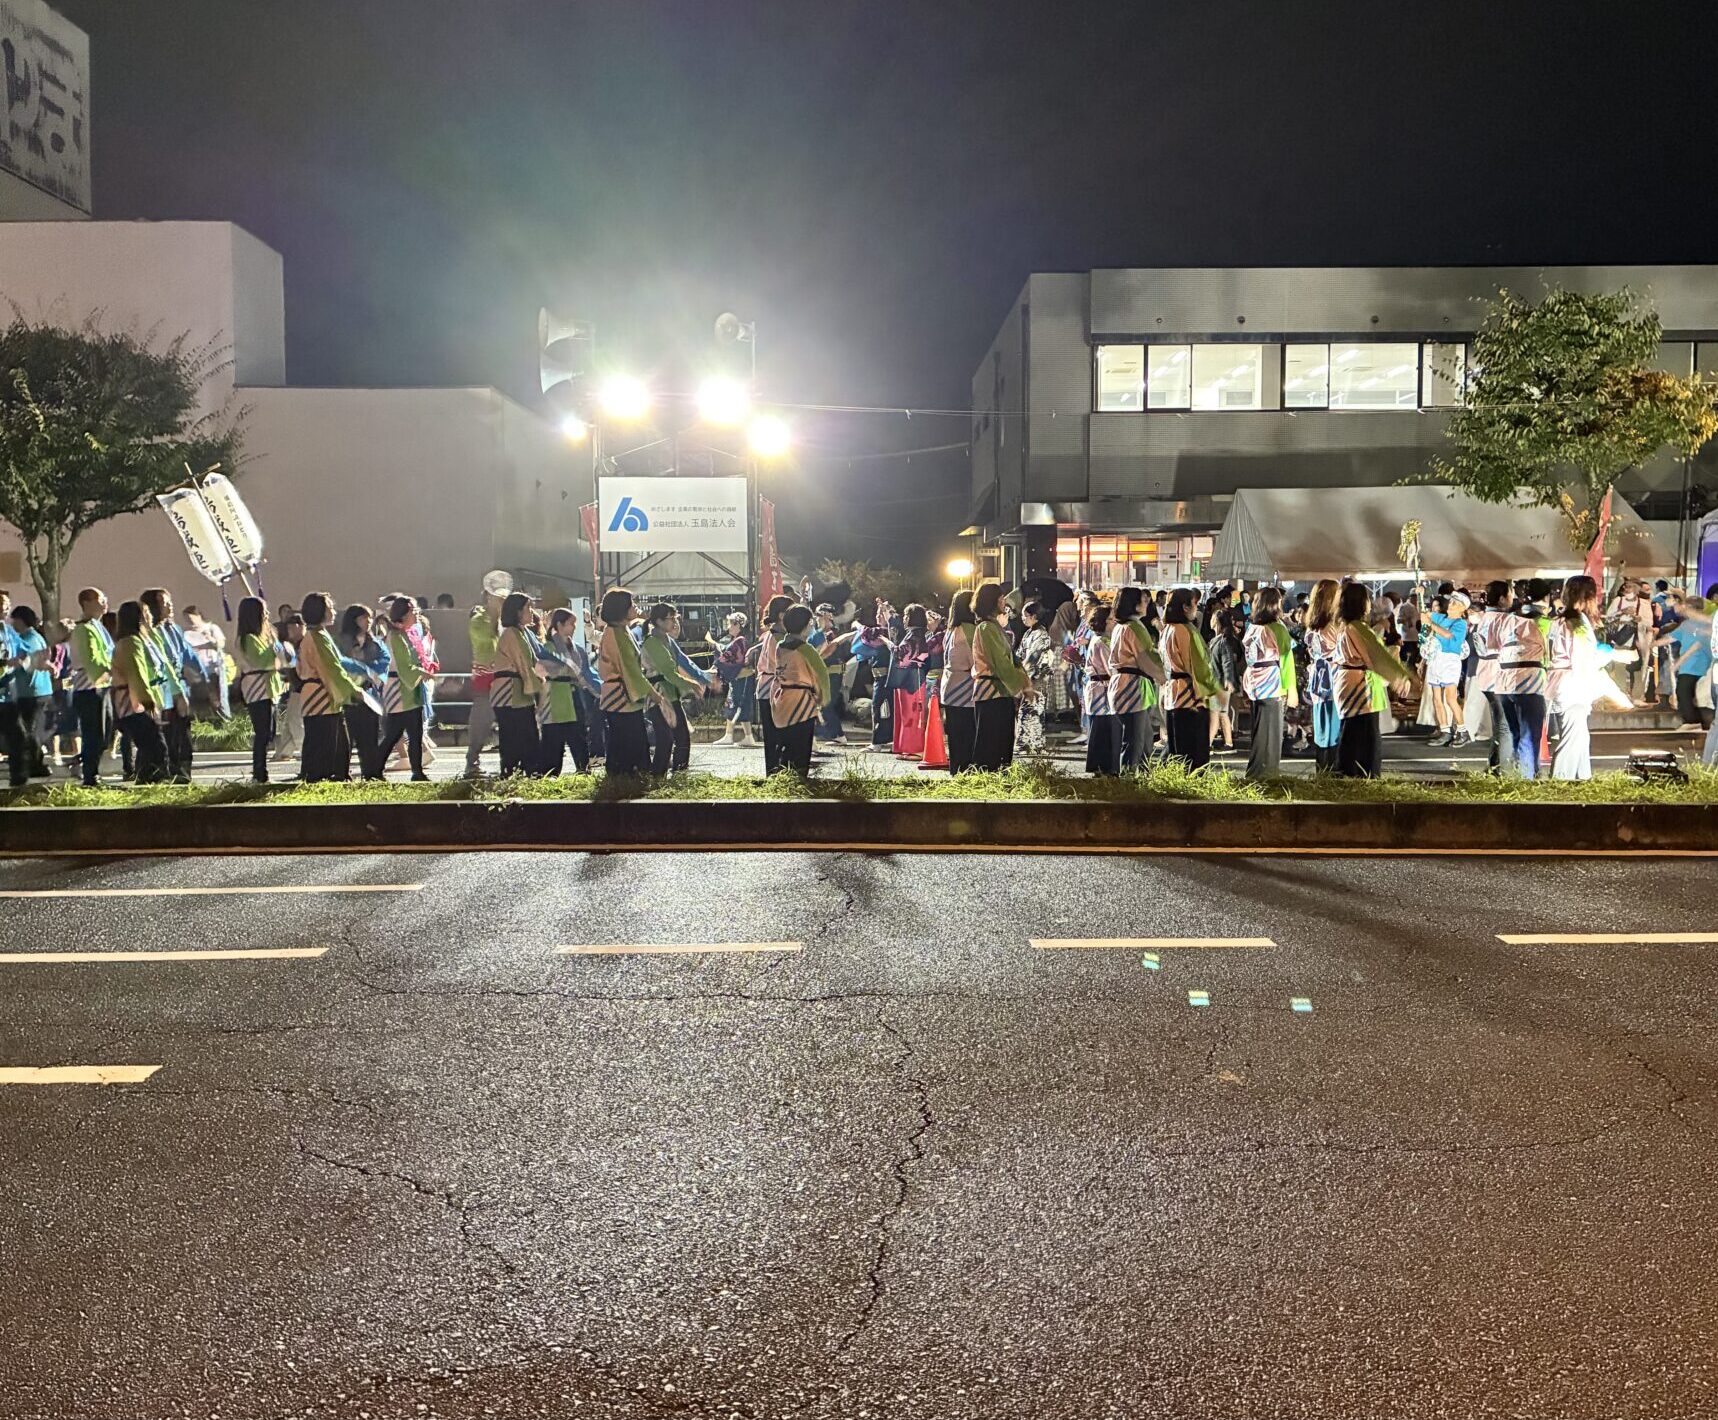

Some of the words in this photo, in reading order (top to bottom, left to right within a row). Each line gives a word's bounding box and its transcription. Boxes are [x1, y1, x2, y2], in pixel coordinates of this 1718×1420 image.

[690, 518, 737, 528] 玉島法人会
